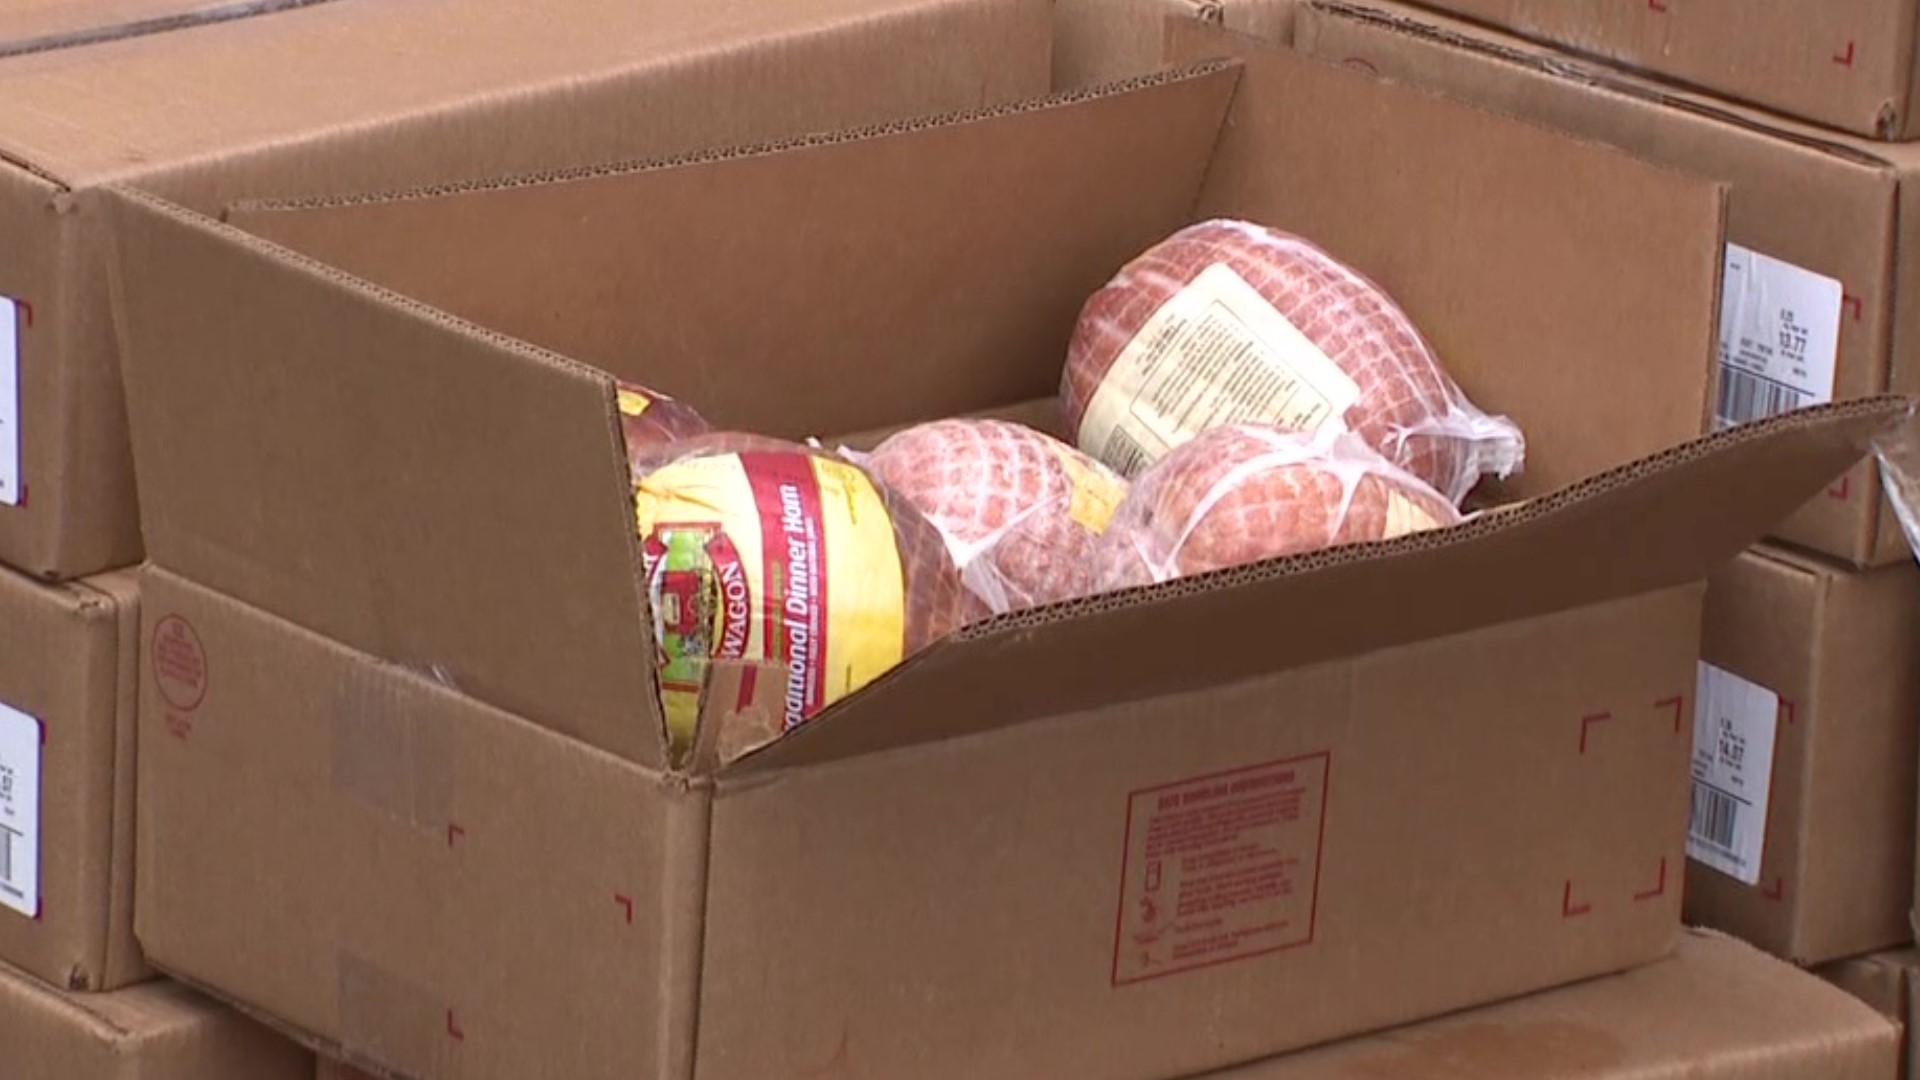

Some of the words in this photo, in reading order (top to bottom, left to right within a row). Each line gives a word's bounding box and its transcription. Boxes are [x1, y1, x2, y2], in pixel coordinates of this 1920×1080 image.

[779, 483, 804, 533] Ham
[721, 562, 748, 659] WAGON
[785, 537, 808, 614] Dinner
